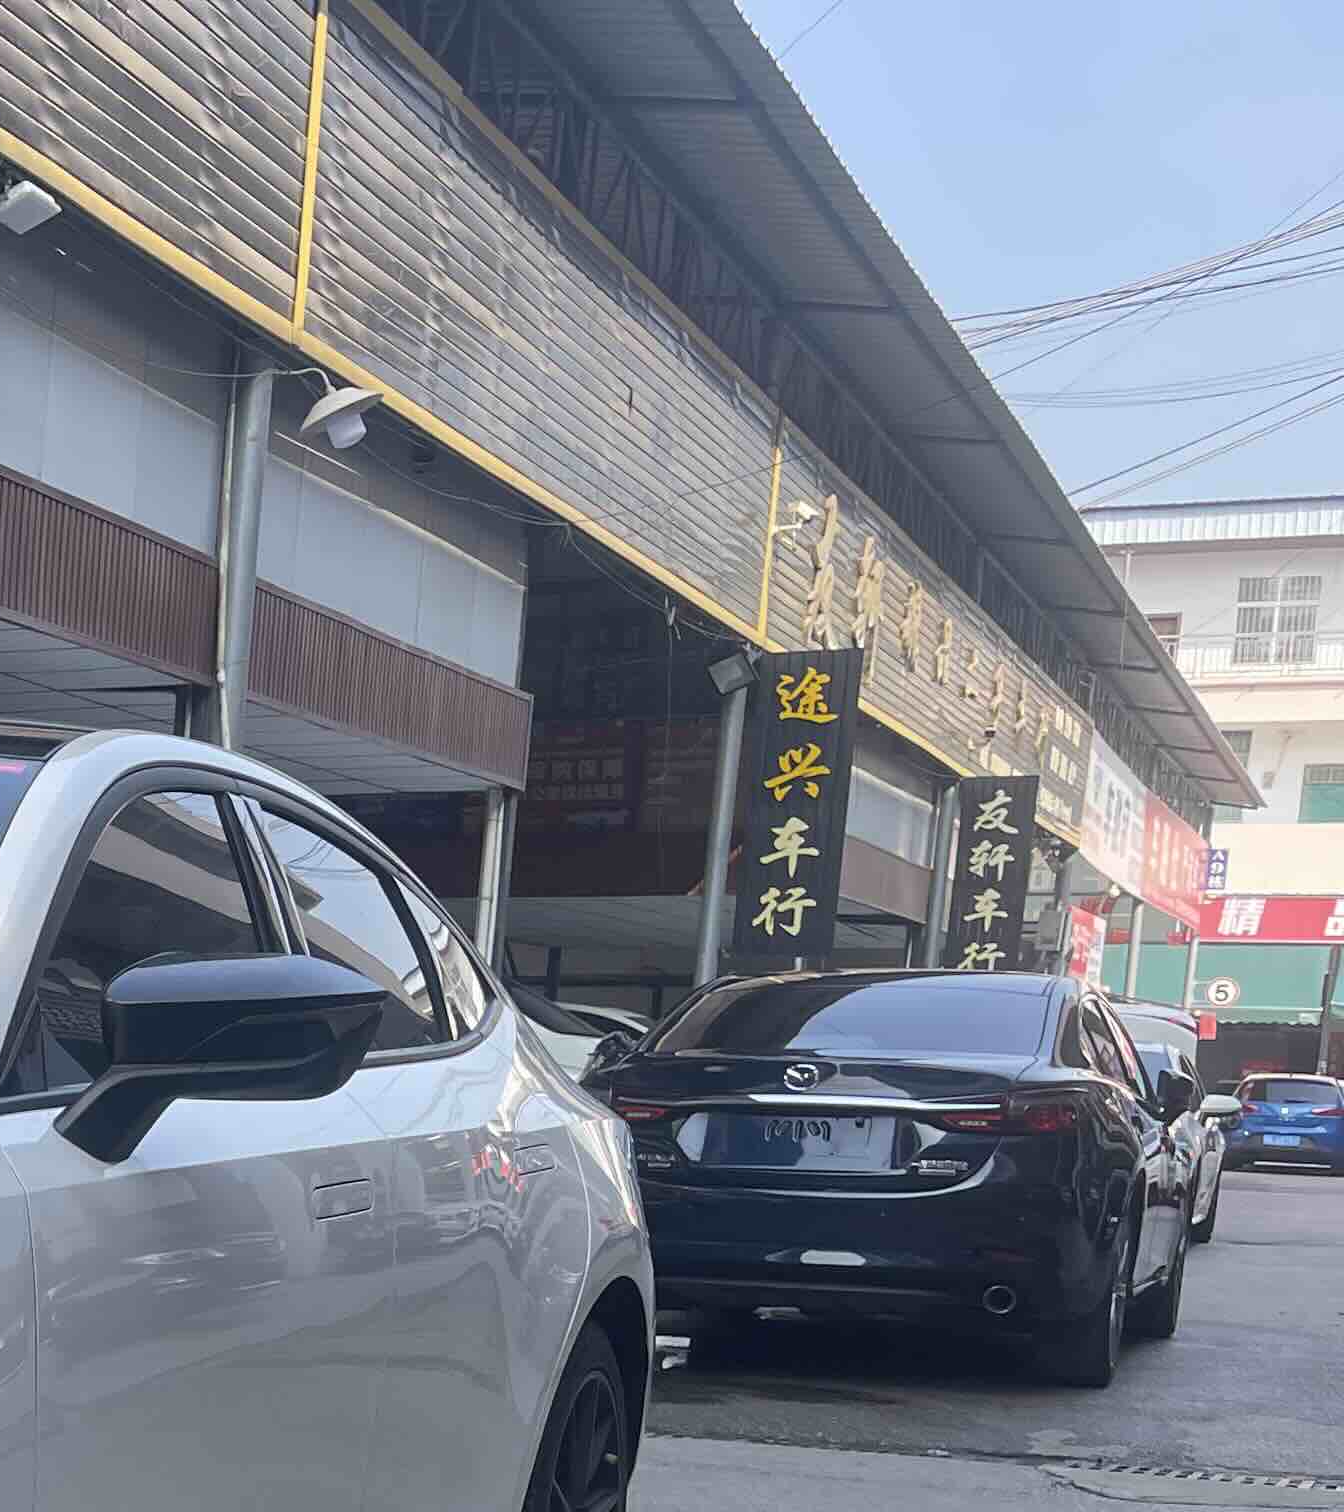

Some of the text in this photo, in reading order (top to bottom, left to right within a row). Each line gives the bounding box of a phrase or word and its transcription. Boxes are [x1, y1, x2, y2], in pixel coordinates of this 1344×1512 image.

[751, 666, 839, 936] 途兴车行
[958, 789, 1019, 971] 友轩车行
[1215, 984, 1230, 1002] 5
